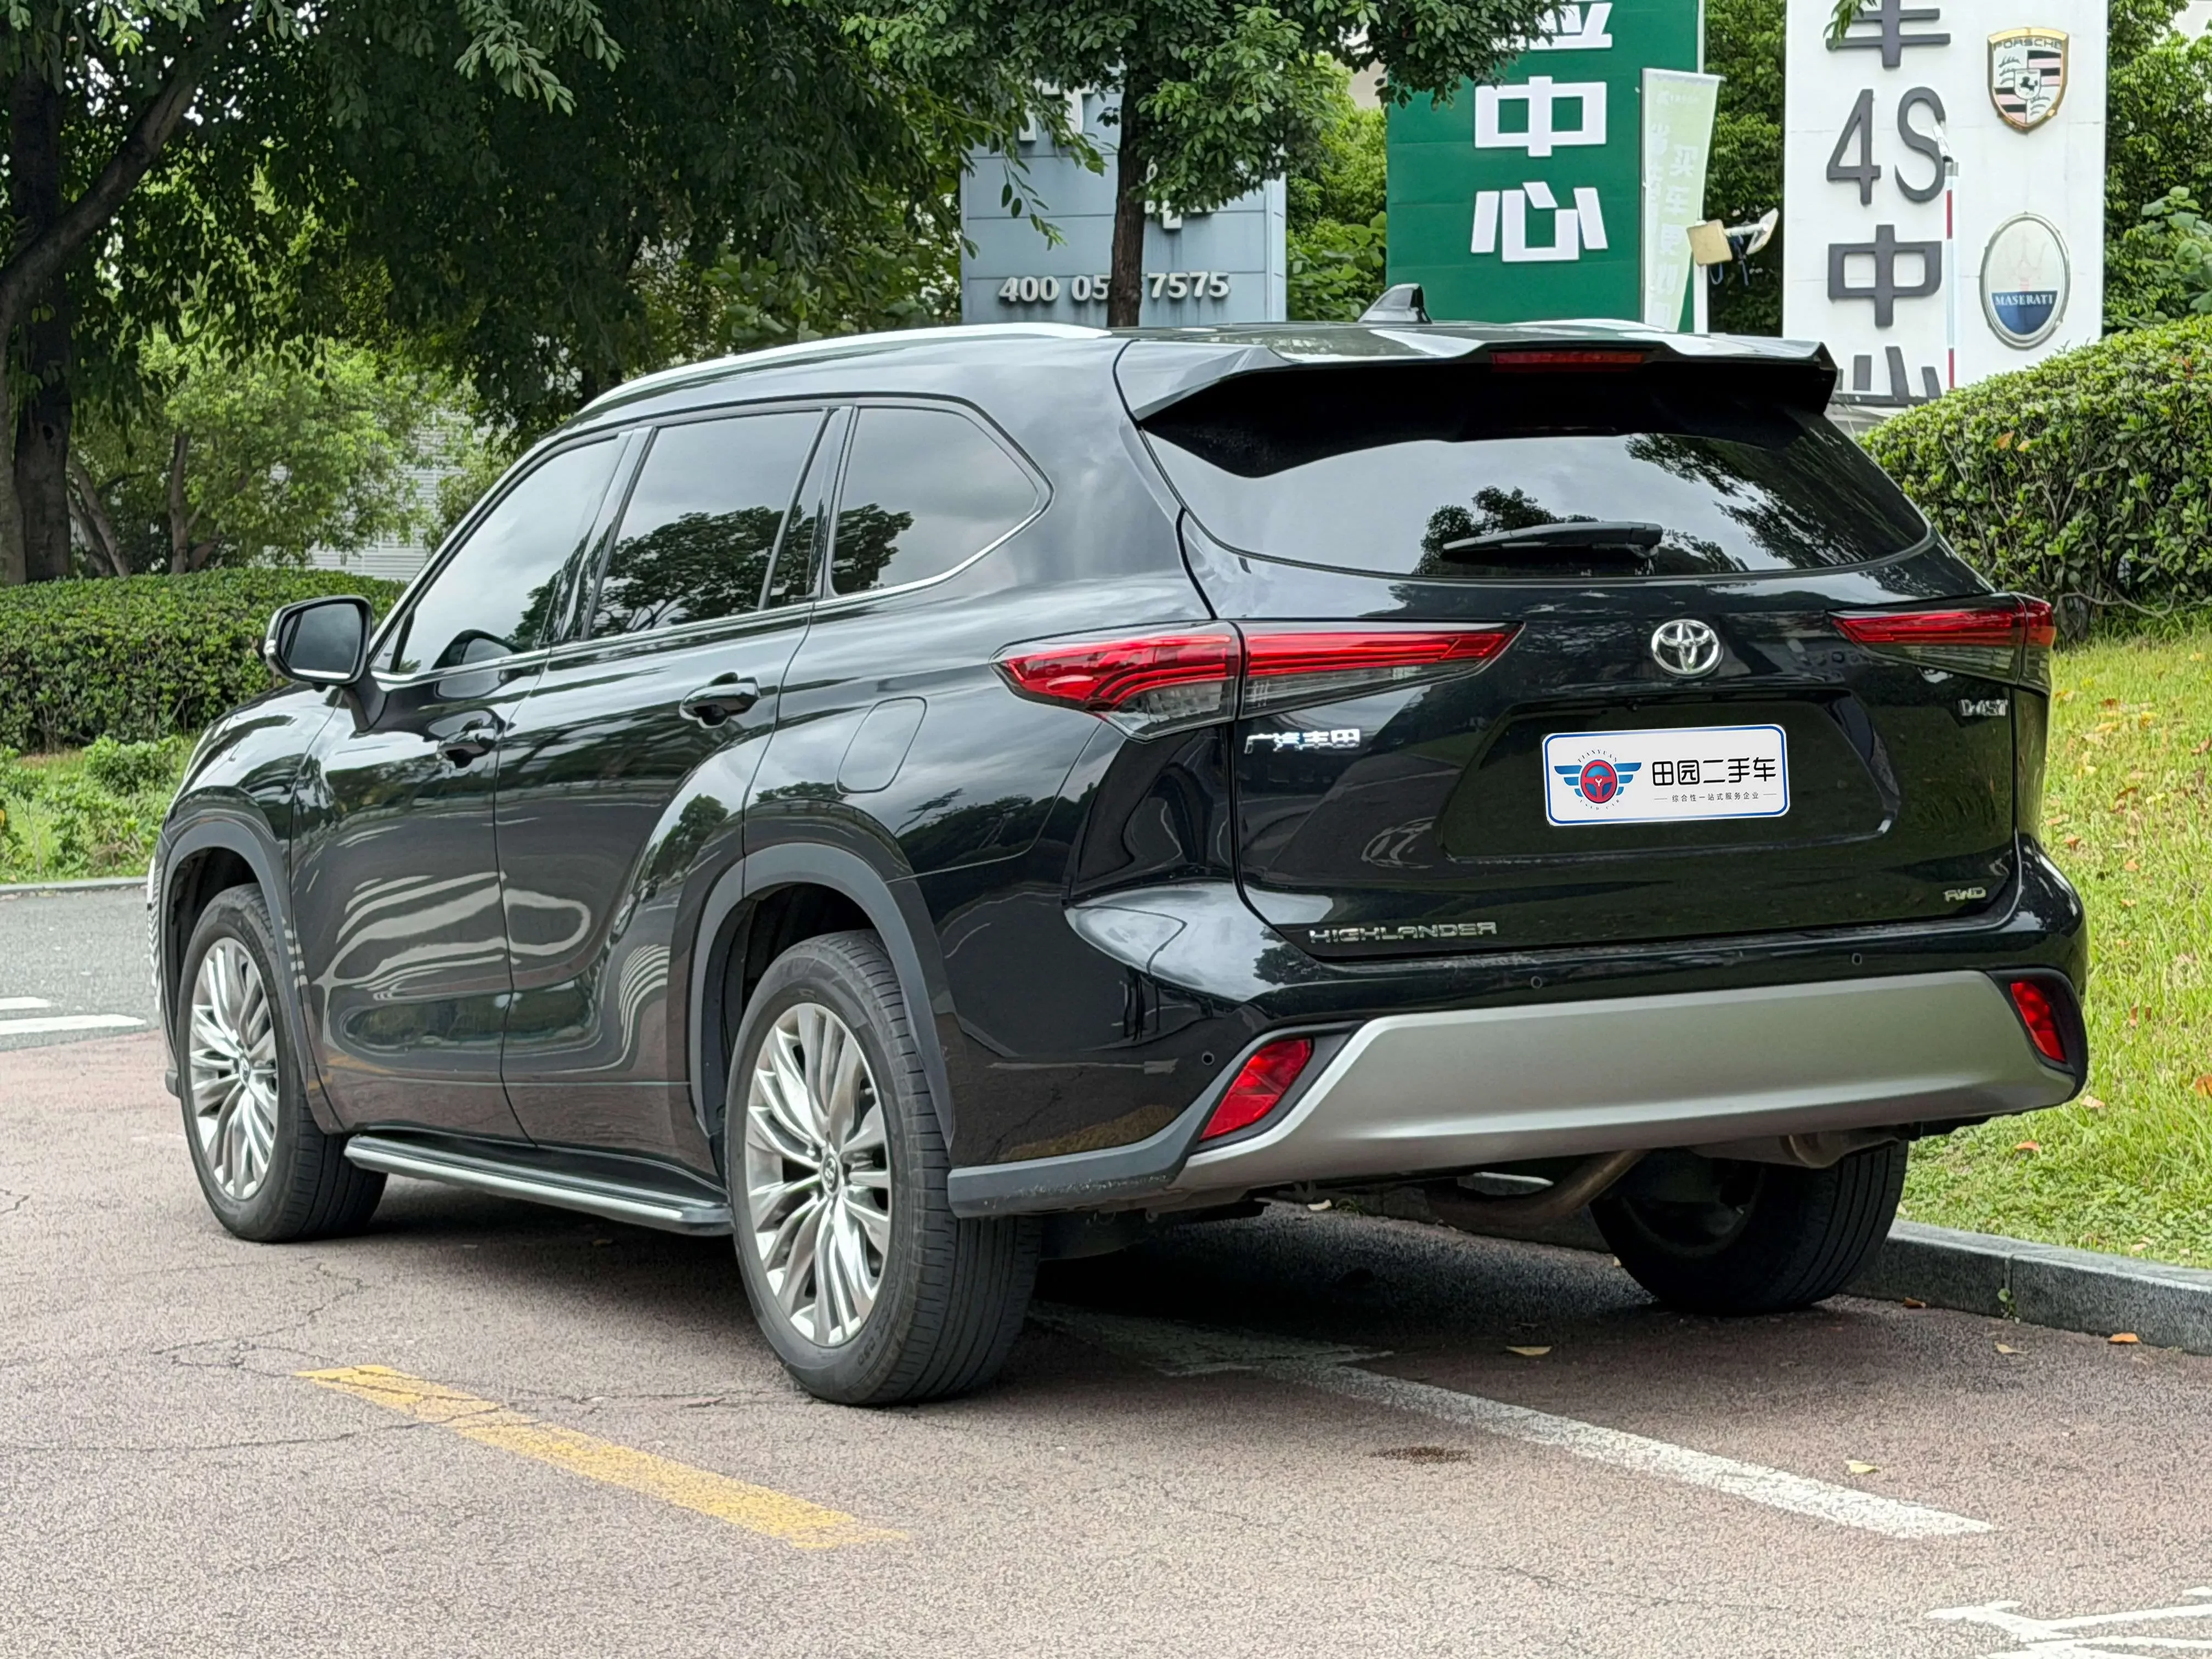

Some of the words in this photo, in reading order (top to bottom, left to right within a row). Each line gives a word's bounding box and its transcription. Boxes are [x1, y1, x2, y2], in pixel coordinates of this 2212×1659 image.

[1994, 36, 2063, 50] PORSCHE
[998, 276, 1060, 302] 400
[1071, 274, 1111, 300] 05
[1148, 272, 1233, 298] 7575
[1995, 294, 2053, 305] MASERATI
[1309, 922, 1498, 943] HIGHLANDER
